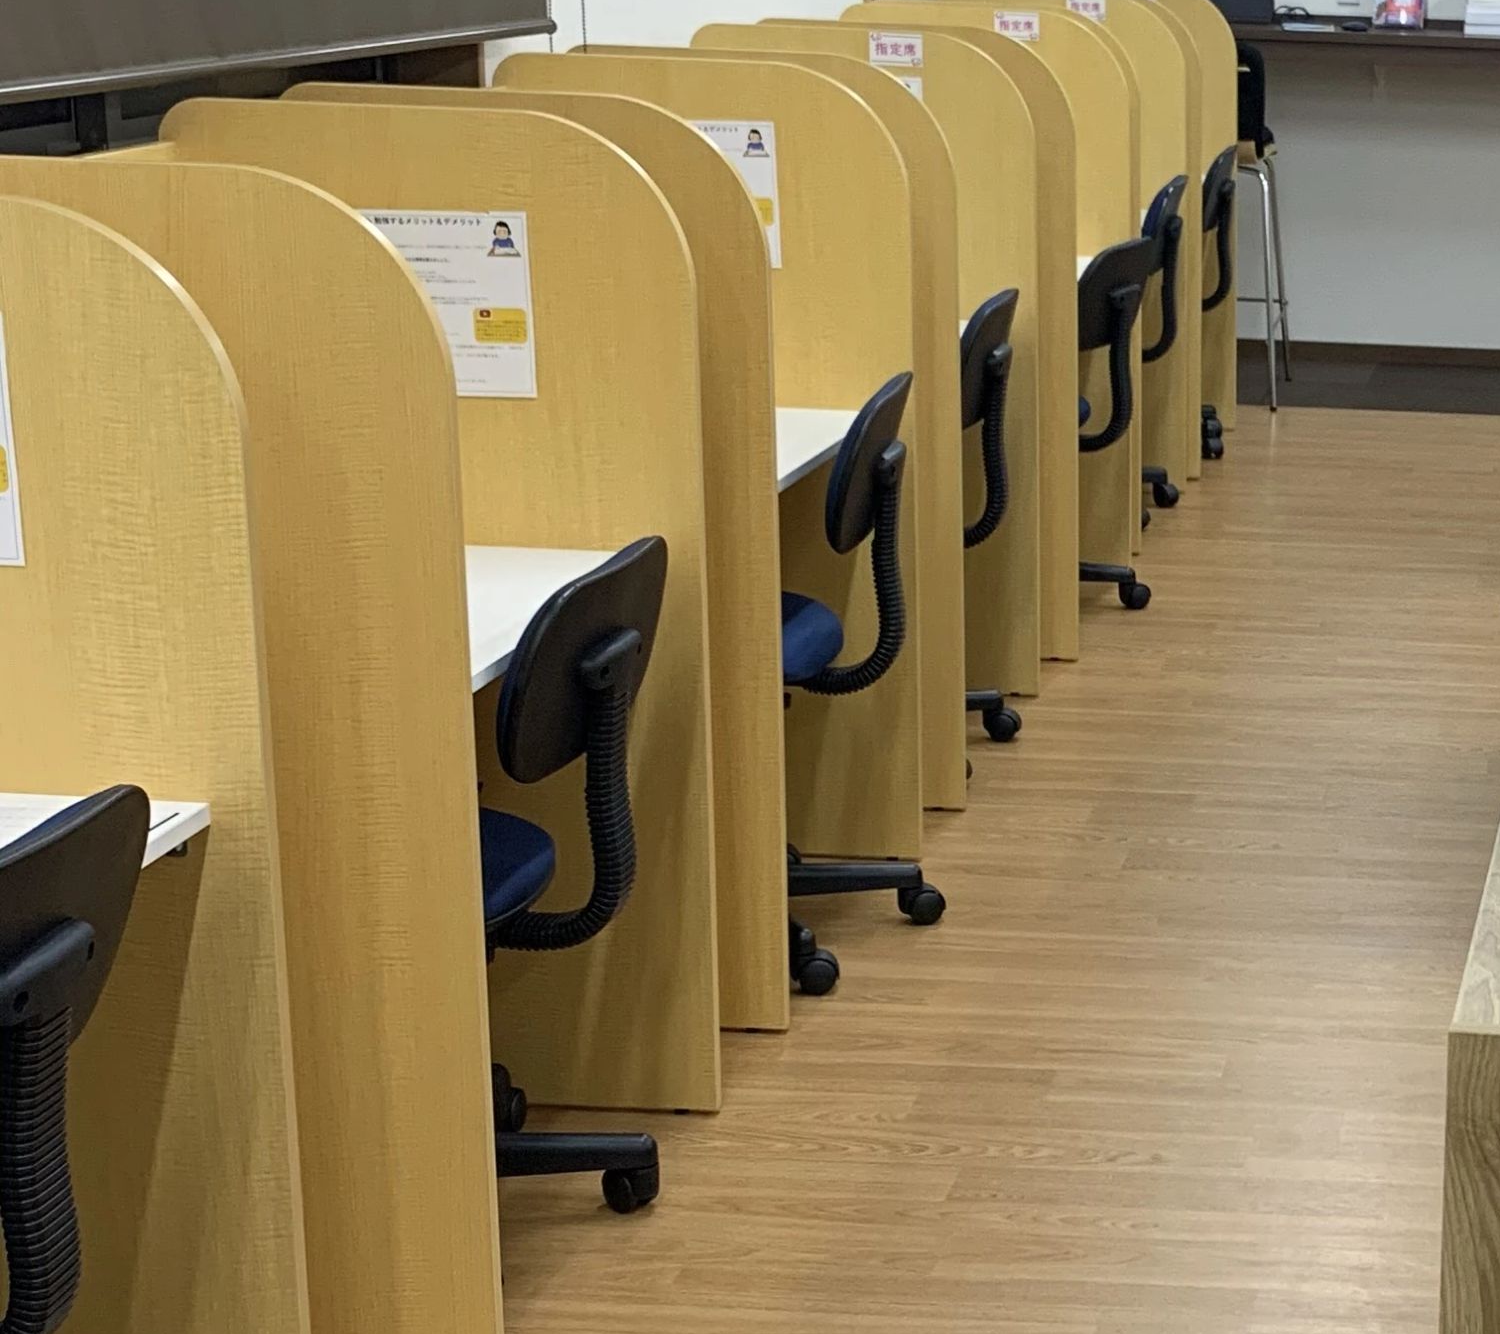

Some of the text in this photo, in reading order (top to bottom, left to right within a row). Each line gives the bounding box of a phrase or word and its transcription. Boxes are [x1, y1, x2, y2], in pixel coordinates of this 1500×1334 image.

[999, 20, 1034, 31] 指定席
[875, 43, 916, 56] 指定席
